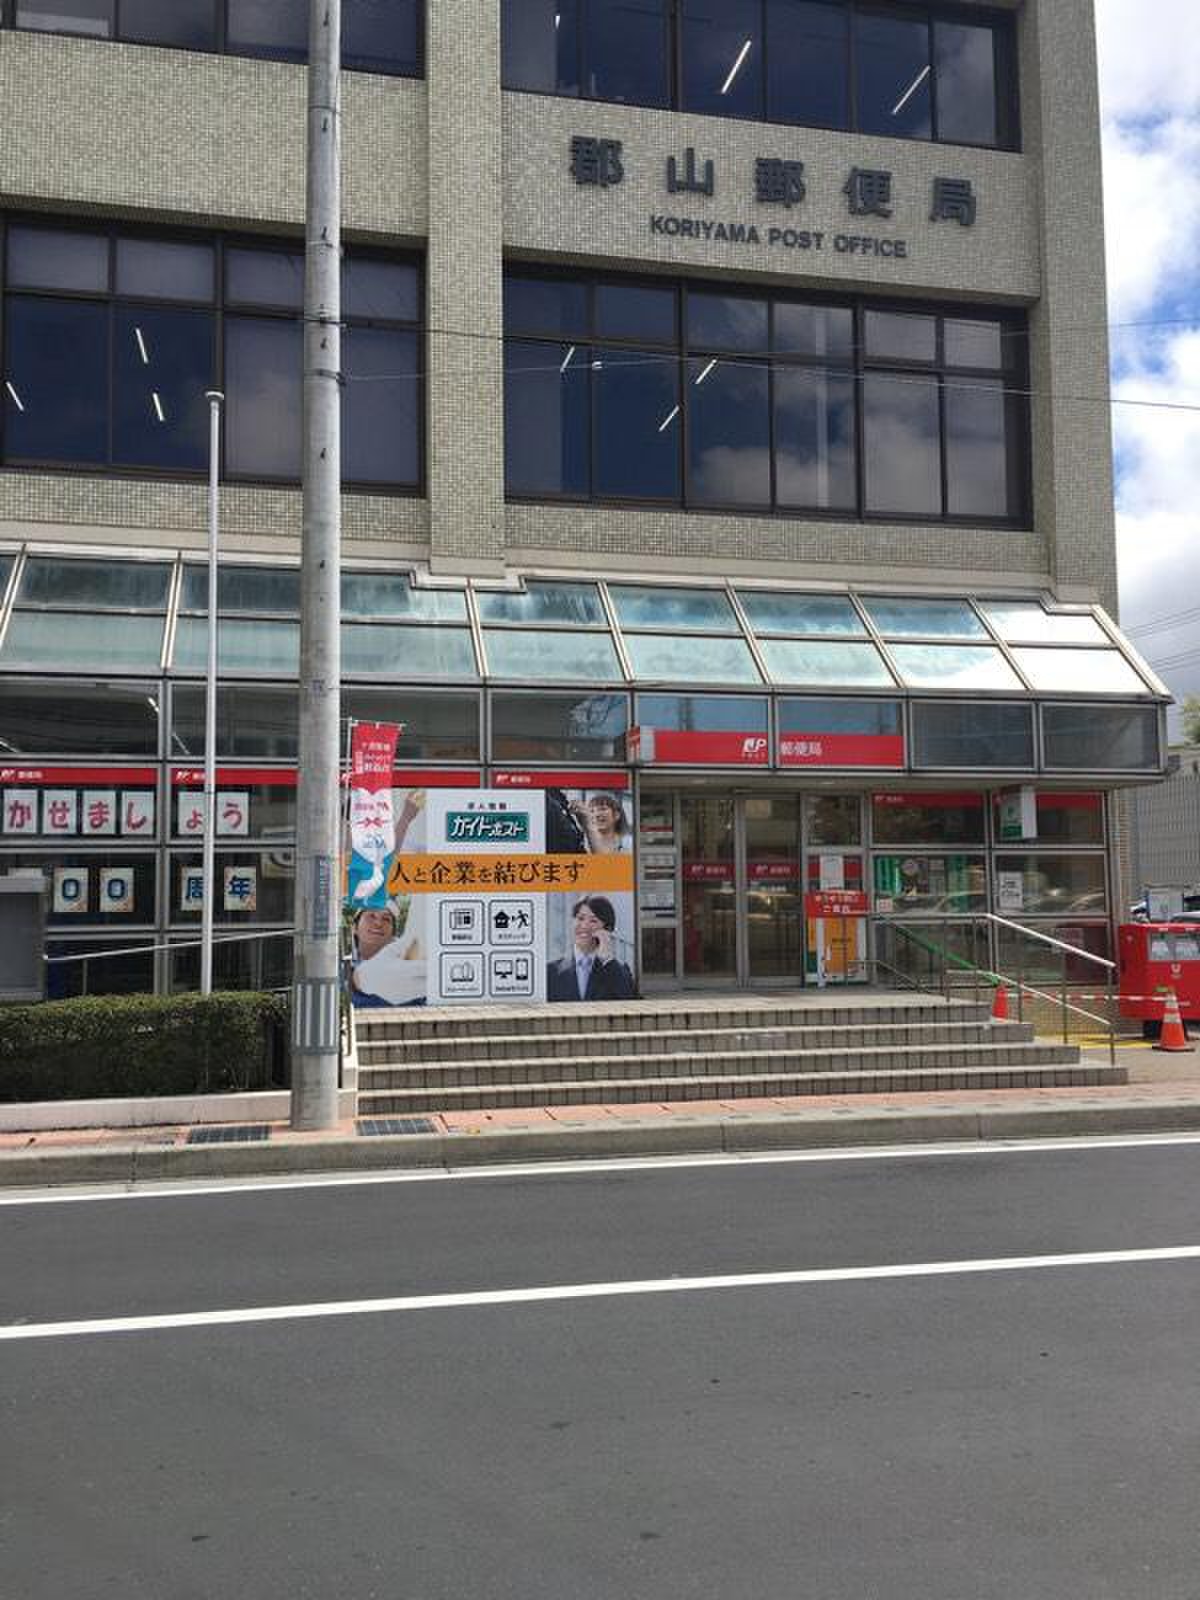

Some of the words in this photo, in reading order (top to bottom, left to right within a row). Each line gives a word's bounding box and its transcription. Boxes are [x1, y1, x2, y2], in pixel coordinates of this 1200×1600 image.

[570, 135, 977, 226] 郡山郵便局
[650, 214, 760, 245] KORIYAMA
[768, 228, 825, 250] POST
[833, 234, 907, 258] OFFICE
[390, 861, 585, 885] 人と企業を結びます
